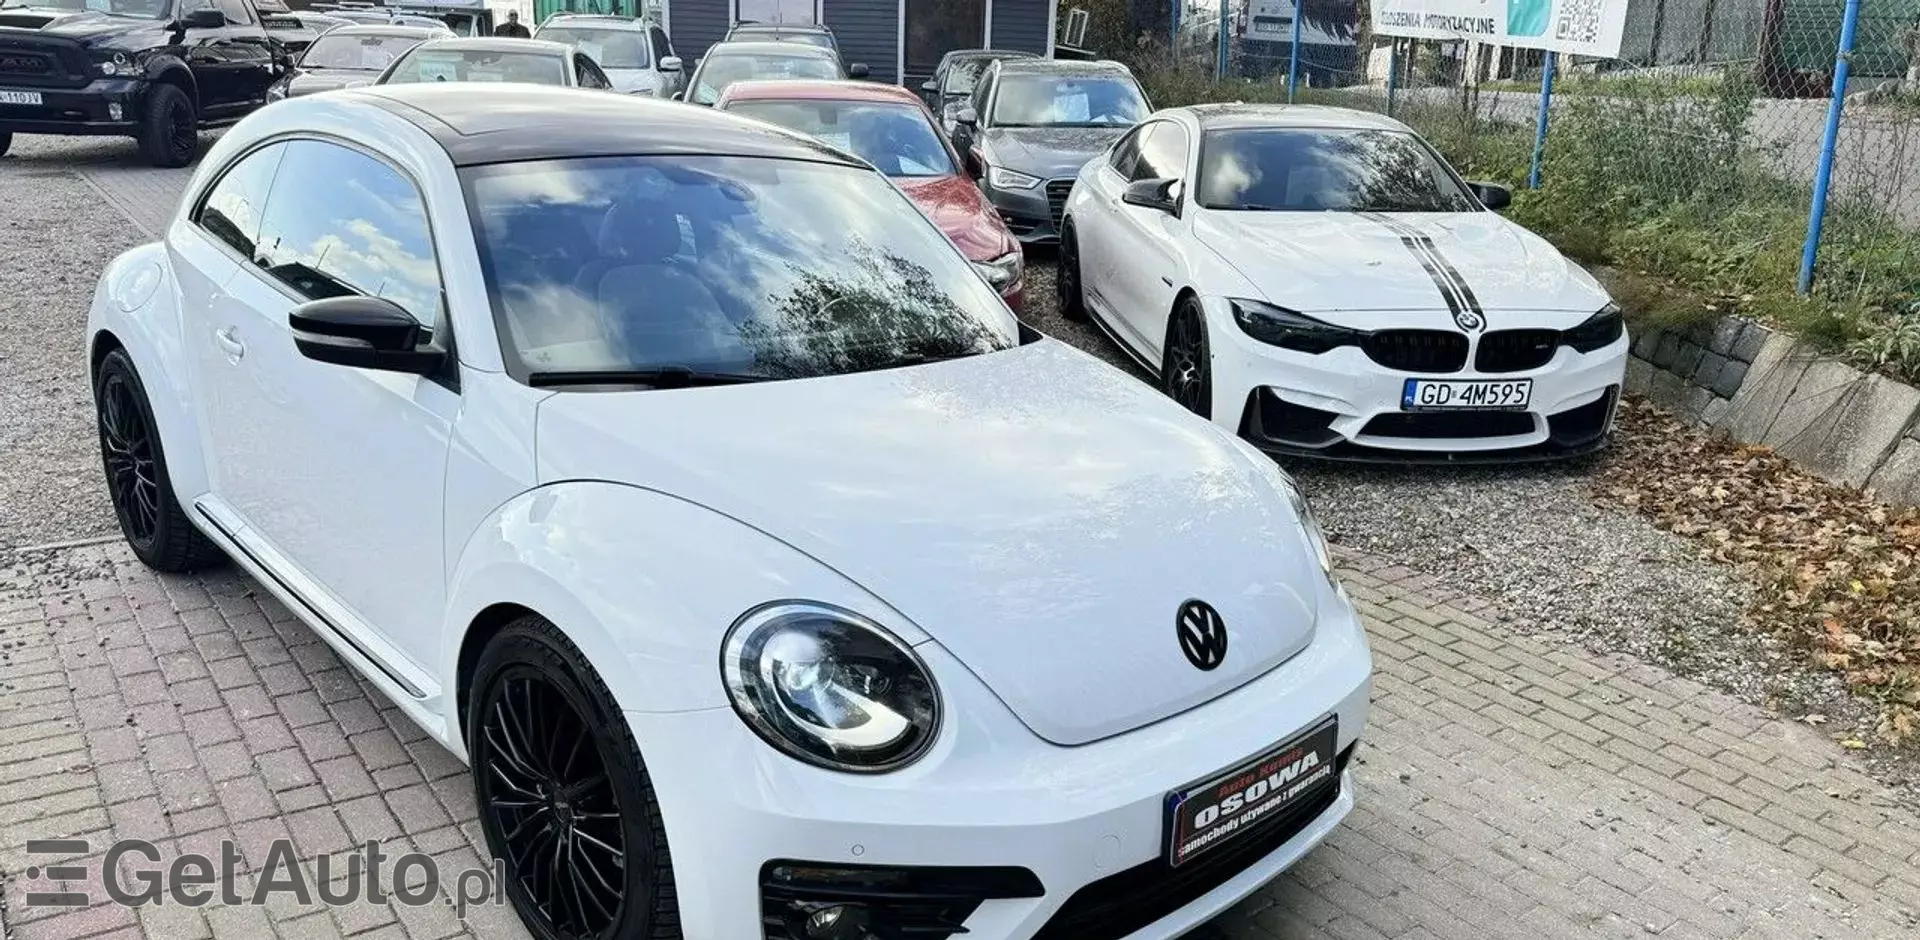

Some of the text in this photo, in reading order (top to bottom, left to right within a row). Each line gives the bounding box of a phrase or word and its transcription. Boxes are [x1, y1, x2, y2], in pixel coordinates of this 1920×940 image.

[1421, 383, 1527, 405] GD 4M595
[1194, 750, 1320, 829] OSOWA
[1178, 817, 1239, 857] samochody
